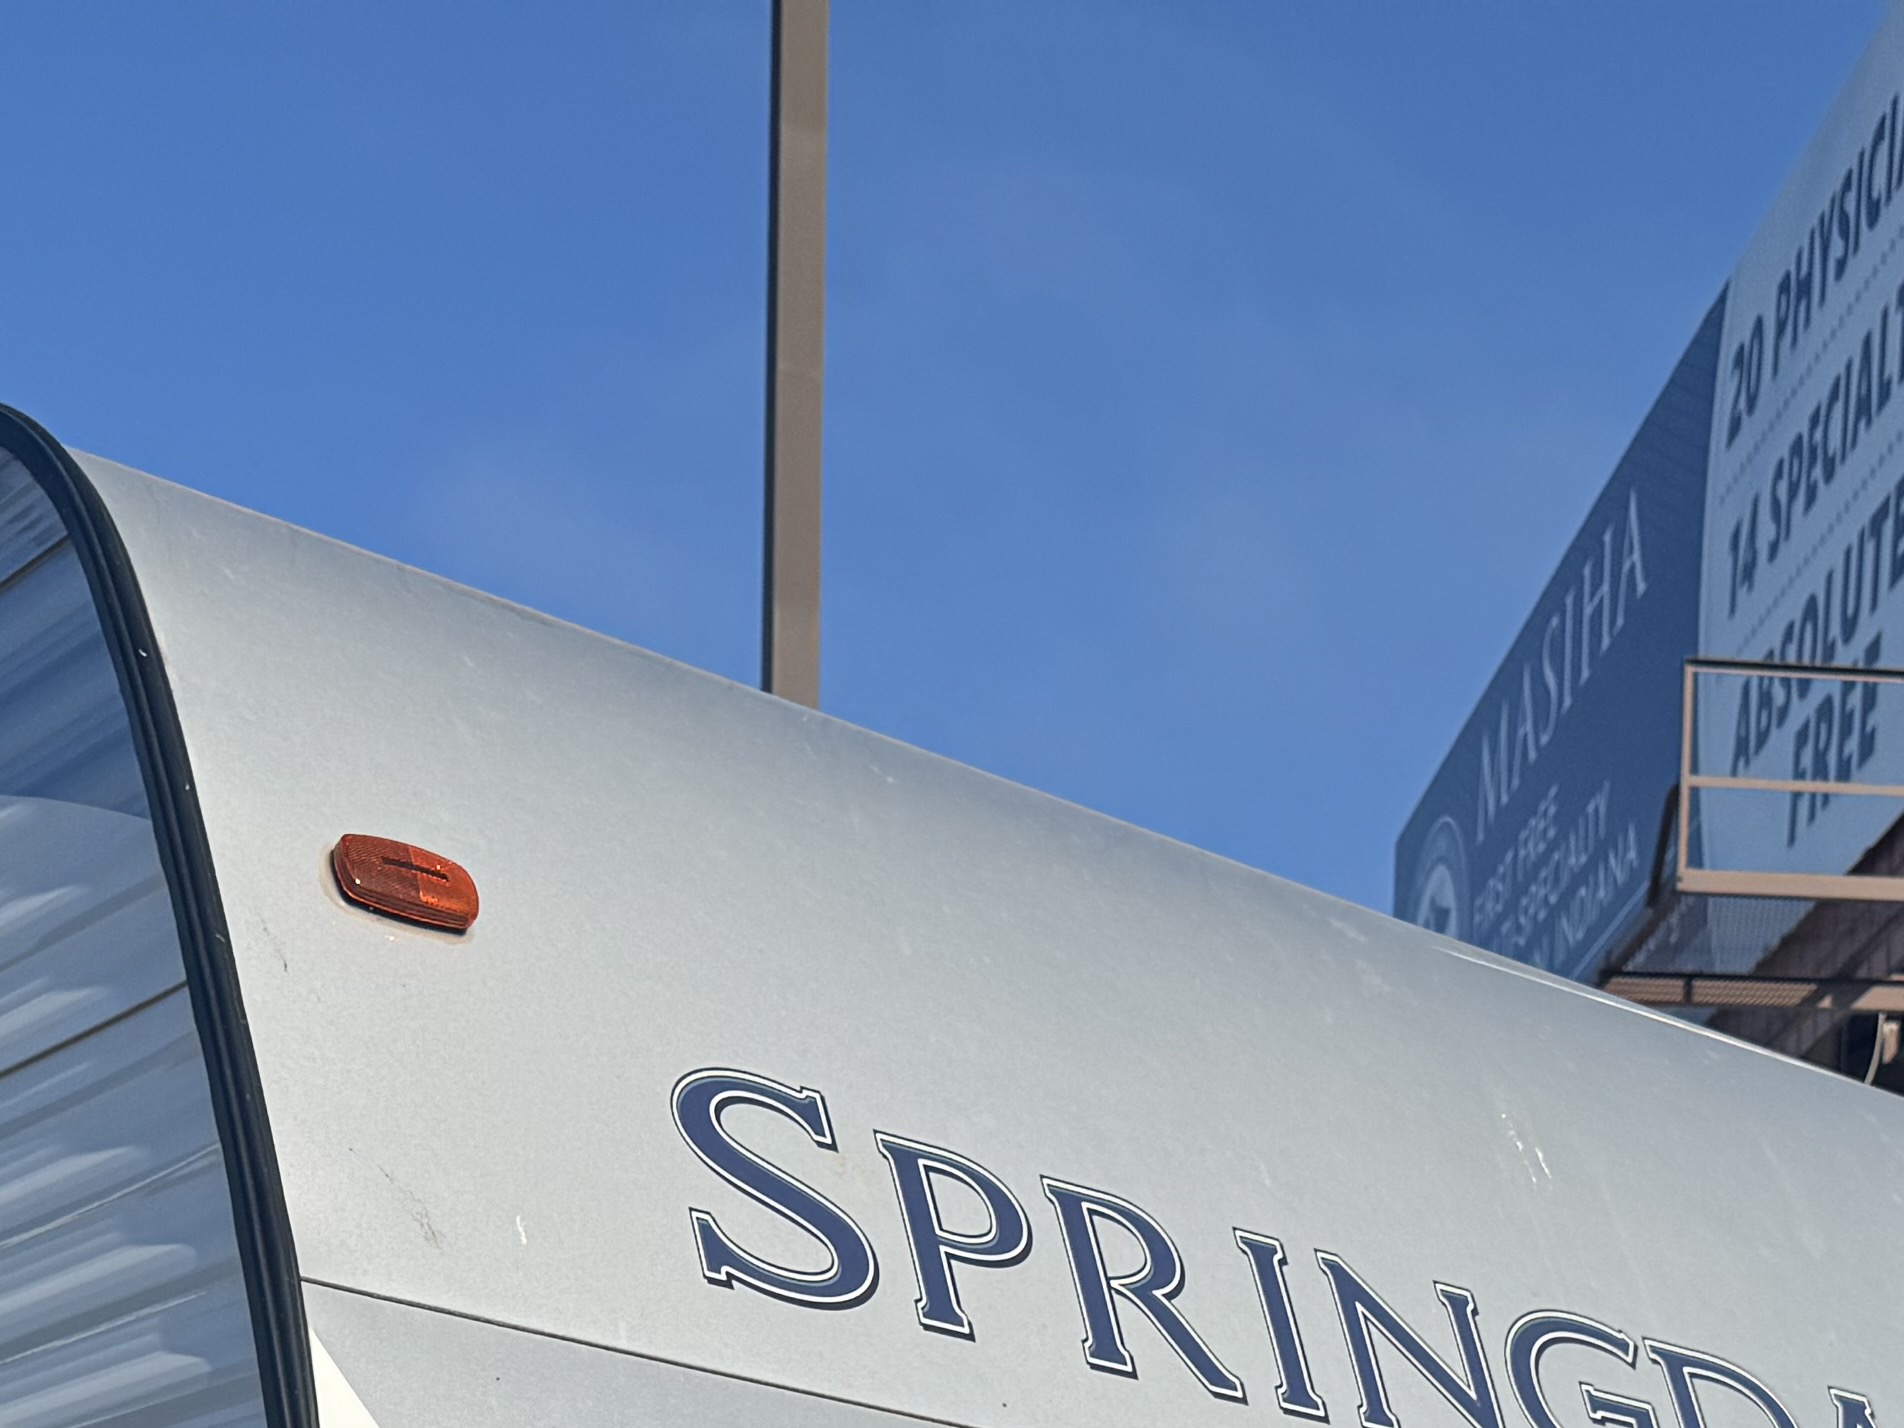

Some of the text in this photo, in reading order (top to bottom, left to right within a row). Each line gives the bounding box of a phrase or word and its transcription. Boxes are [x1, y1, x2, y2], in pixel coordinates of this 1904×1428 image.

[1727, 314, 1763, 450] 20
[1727, 493, 1759, 619] 14
[1474, 487, 1649, 846] MASIHA
[1787, 630, 1883, 848] FREE
